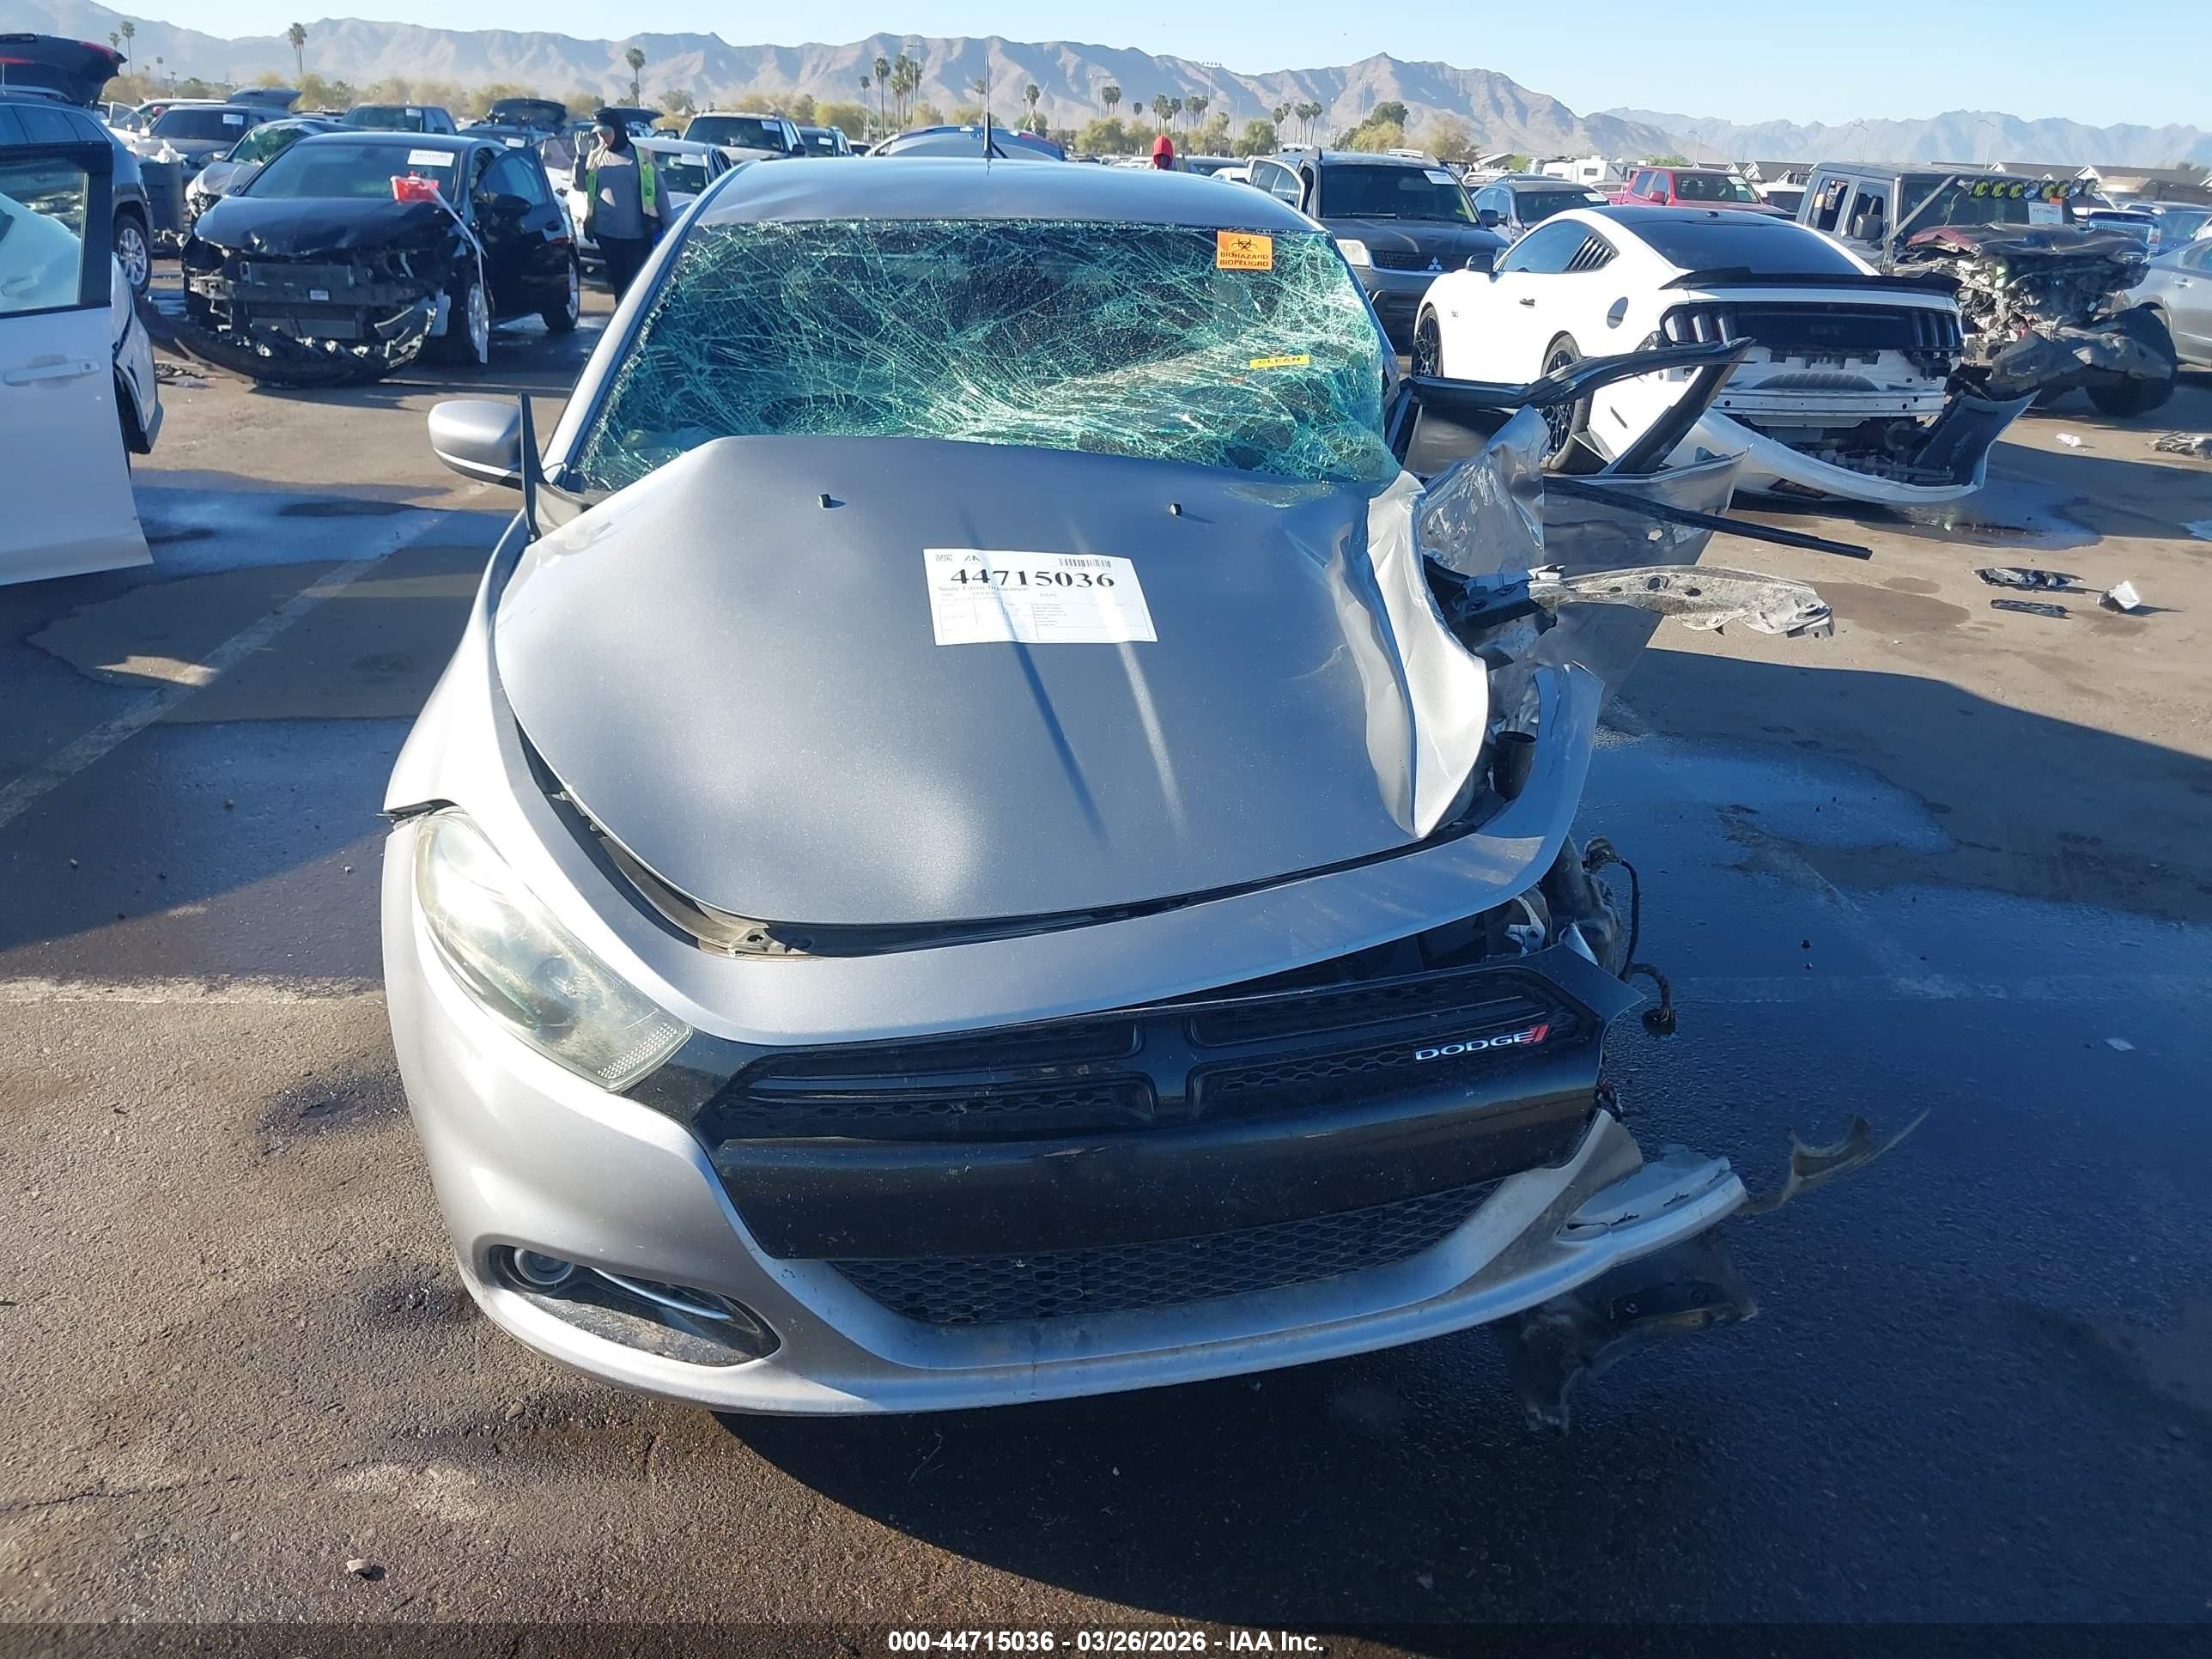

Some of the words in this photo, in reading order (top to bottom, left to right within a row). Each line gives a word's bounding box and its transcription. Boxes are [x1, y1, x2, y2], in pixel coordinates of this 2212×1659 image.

[1258, 356, 1301, 365] CLEAN
[951, 568, 1115, 588] 44715036
[1414, 1030, 1534, 1060] DODGE
